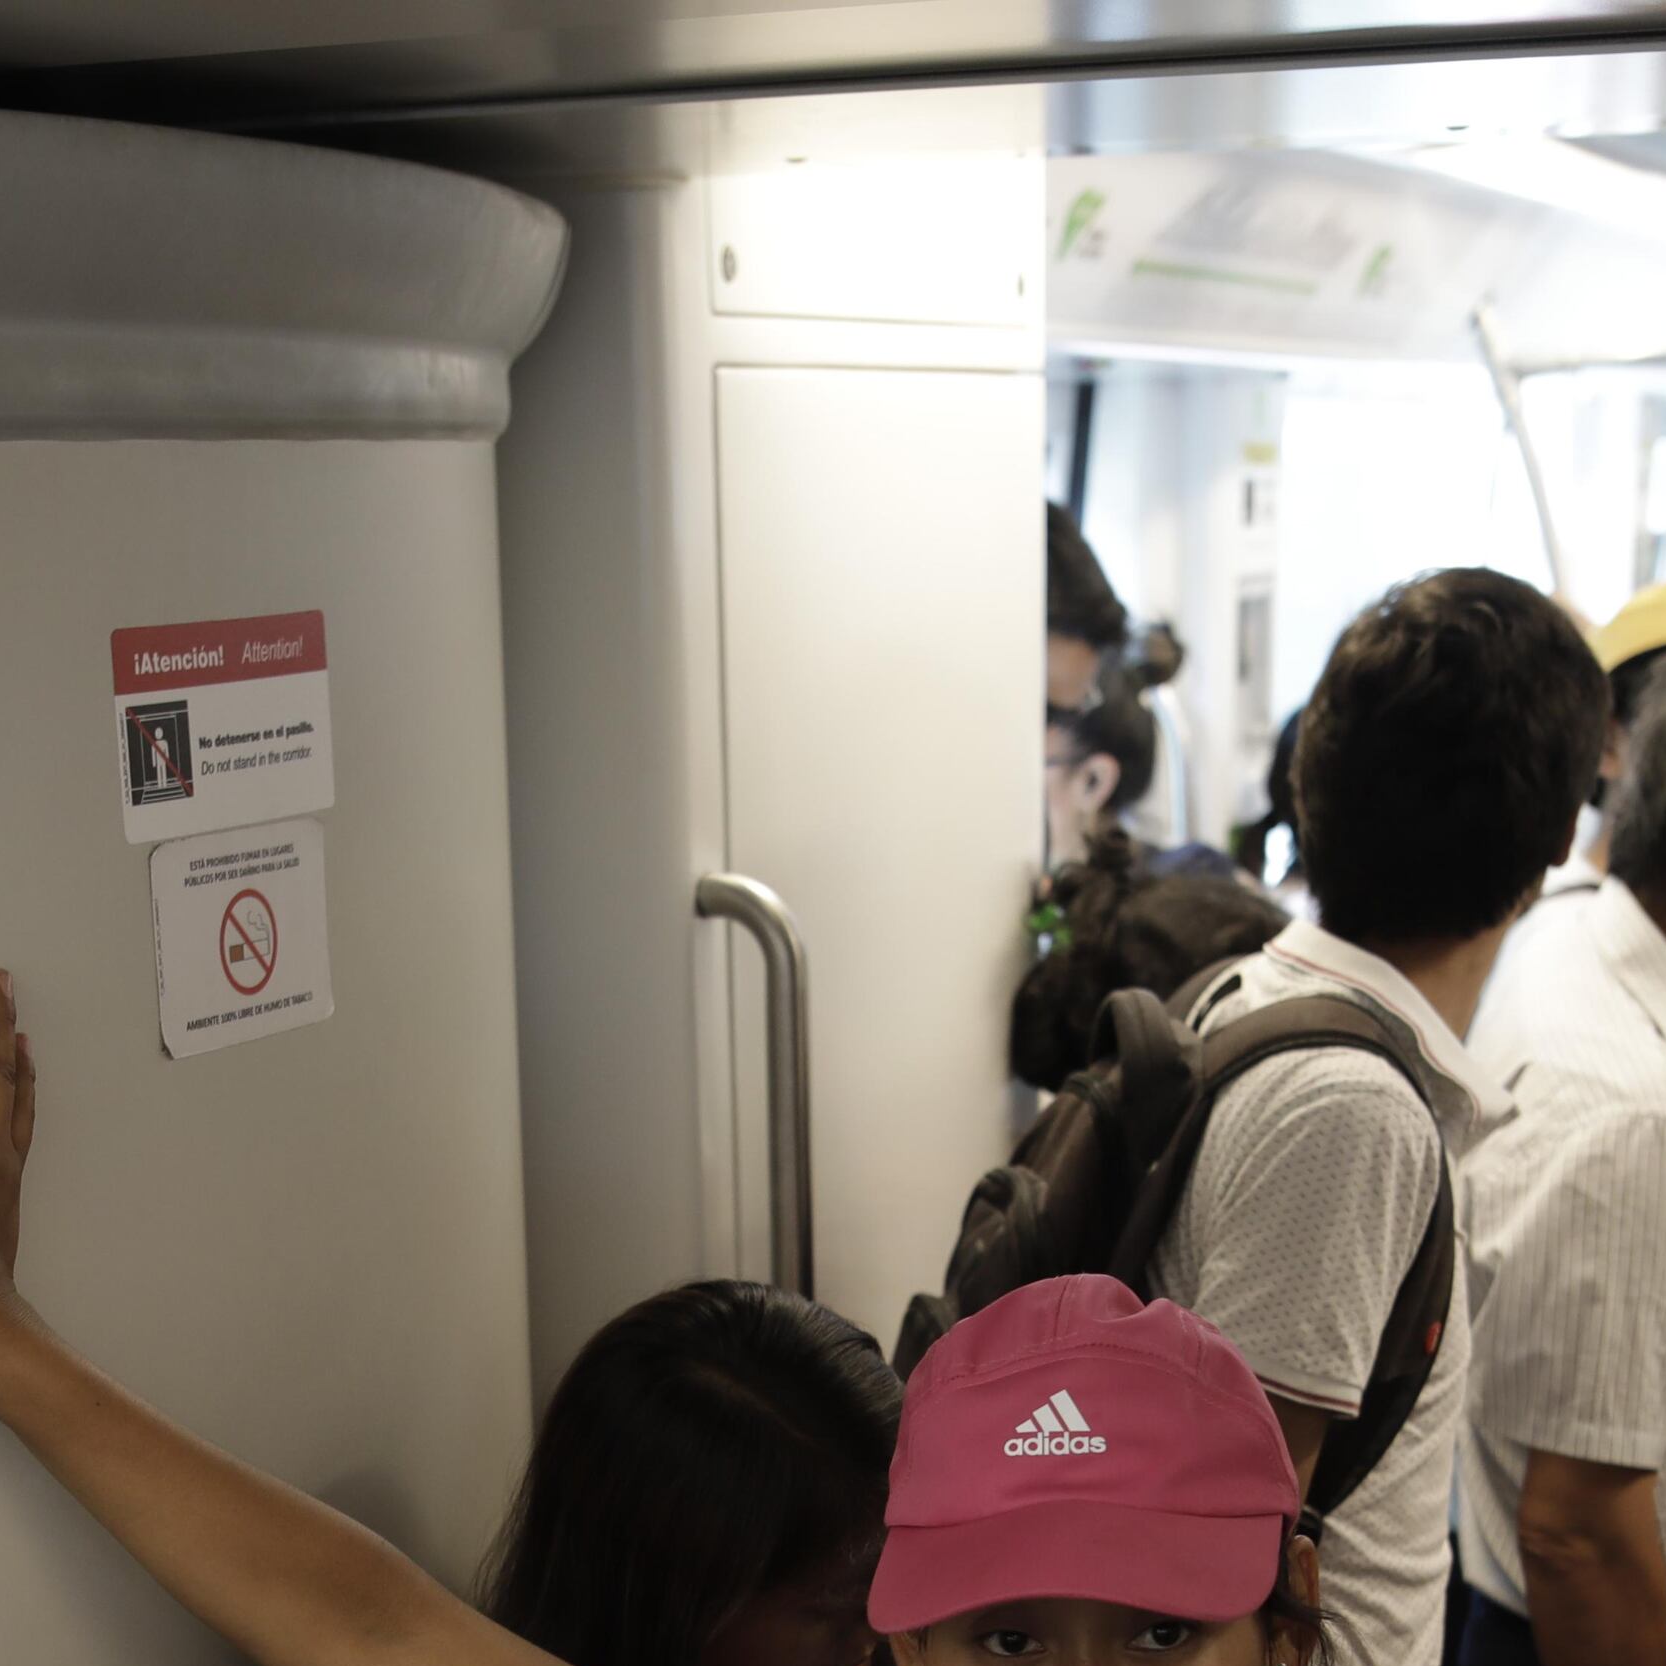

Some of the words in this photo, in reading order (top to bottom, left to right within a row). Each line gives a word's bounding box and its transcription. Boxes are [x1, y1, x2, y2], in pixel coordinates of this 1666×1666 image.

[134, 644, 224, 675] ¡Atención!
[242, 635, 303, 664] Attention!
[199, 736, 212, 749] No
[215, 731, 261, 747] detenerse
[263, 729, 274, 739] en
[276, 725, 284, 737] el
[201, 761, 214, 776] Do
[217, 758, 231, 773] not
[233, 753, 257, 770] stand
[258, 753, 266, 766] in
[268, 750, 280, 765] the
[282, 745, 312, 762] corridor.
[186, 1015, 220, 1032] AMBIENTE
[255, 1004, 263, 1015] DE
[1004, 1432, 1107, 1457] adidas
